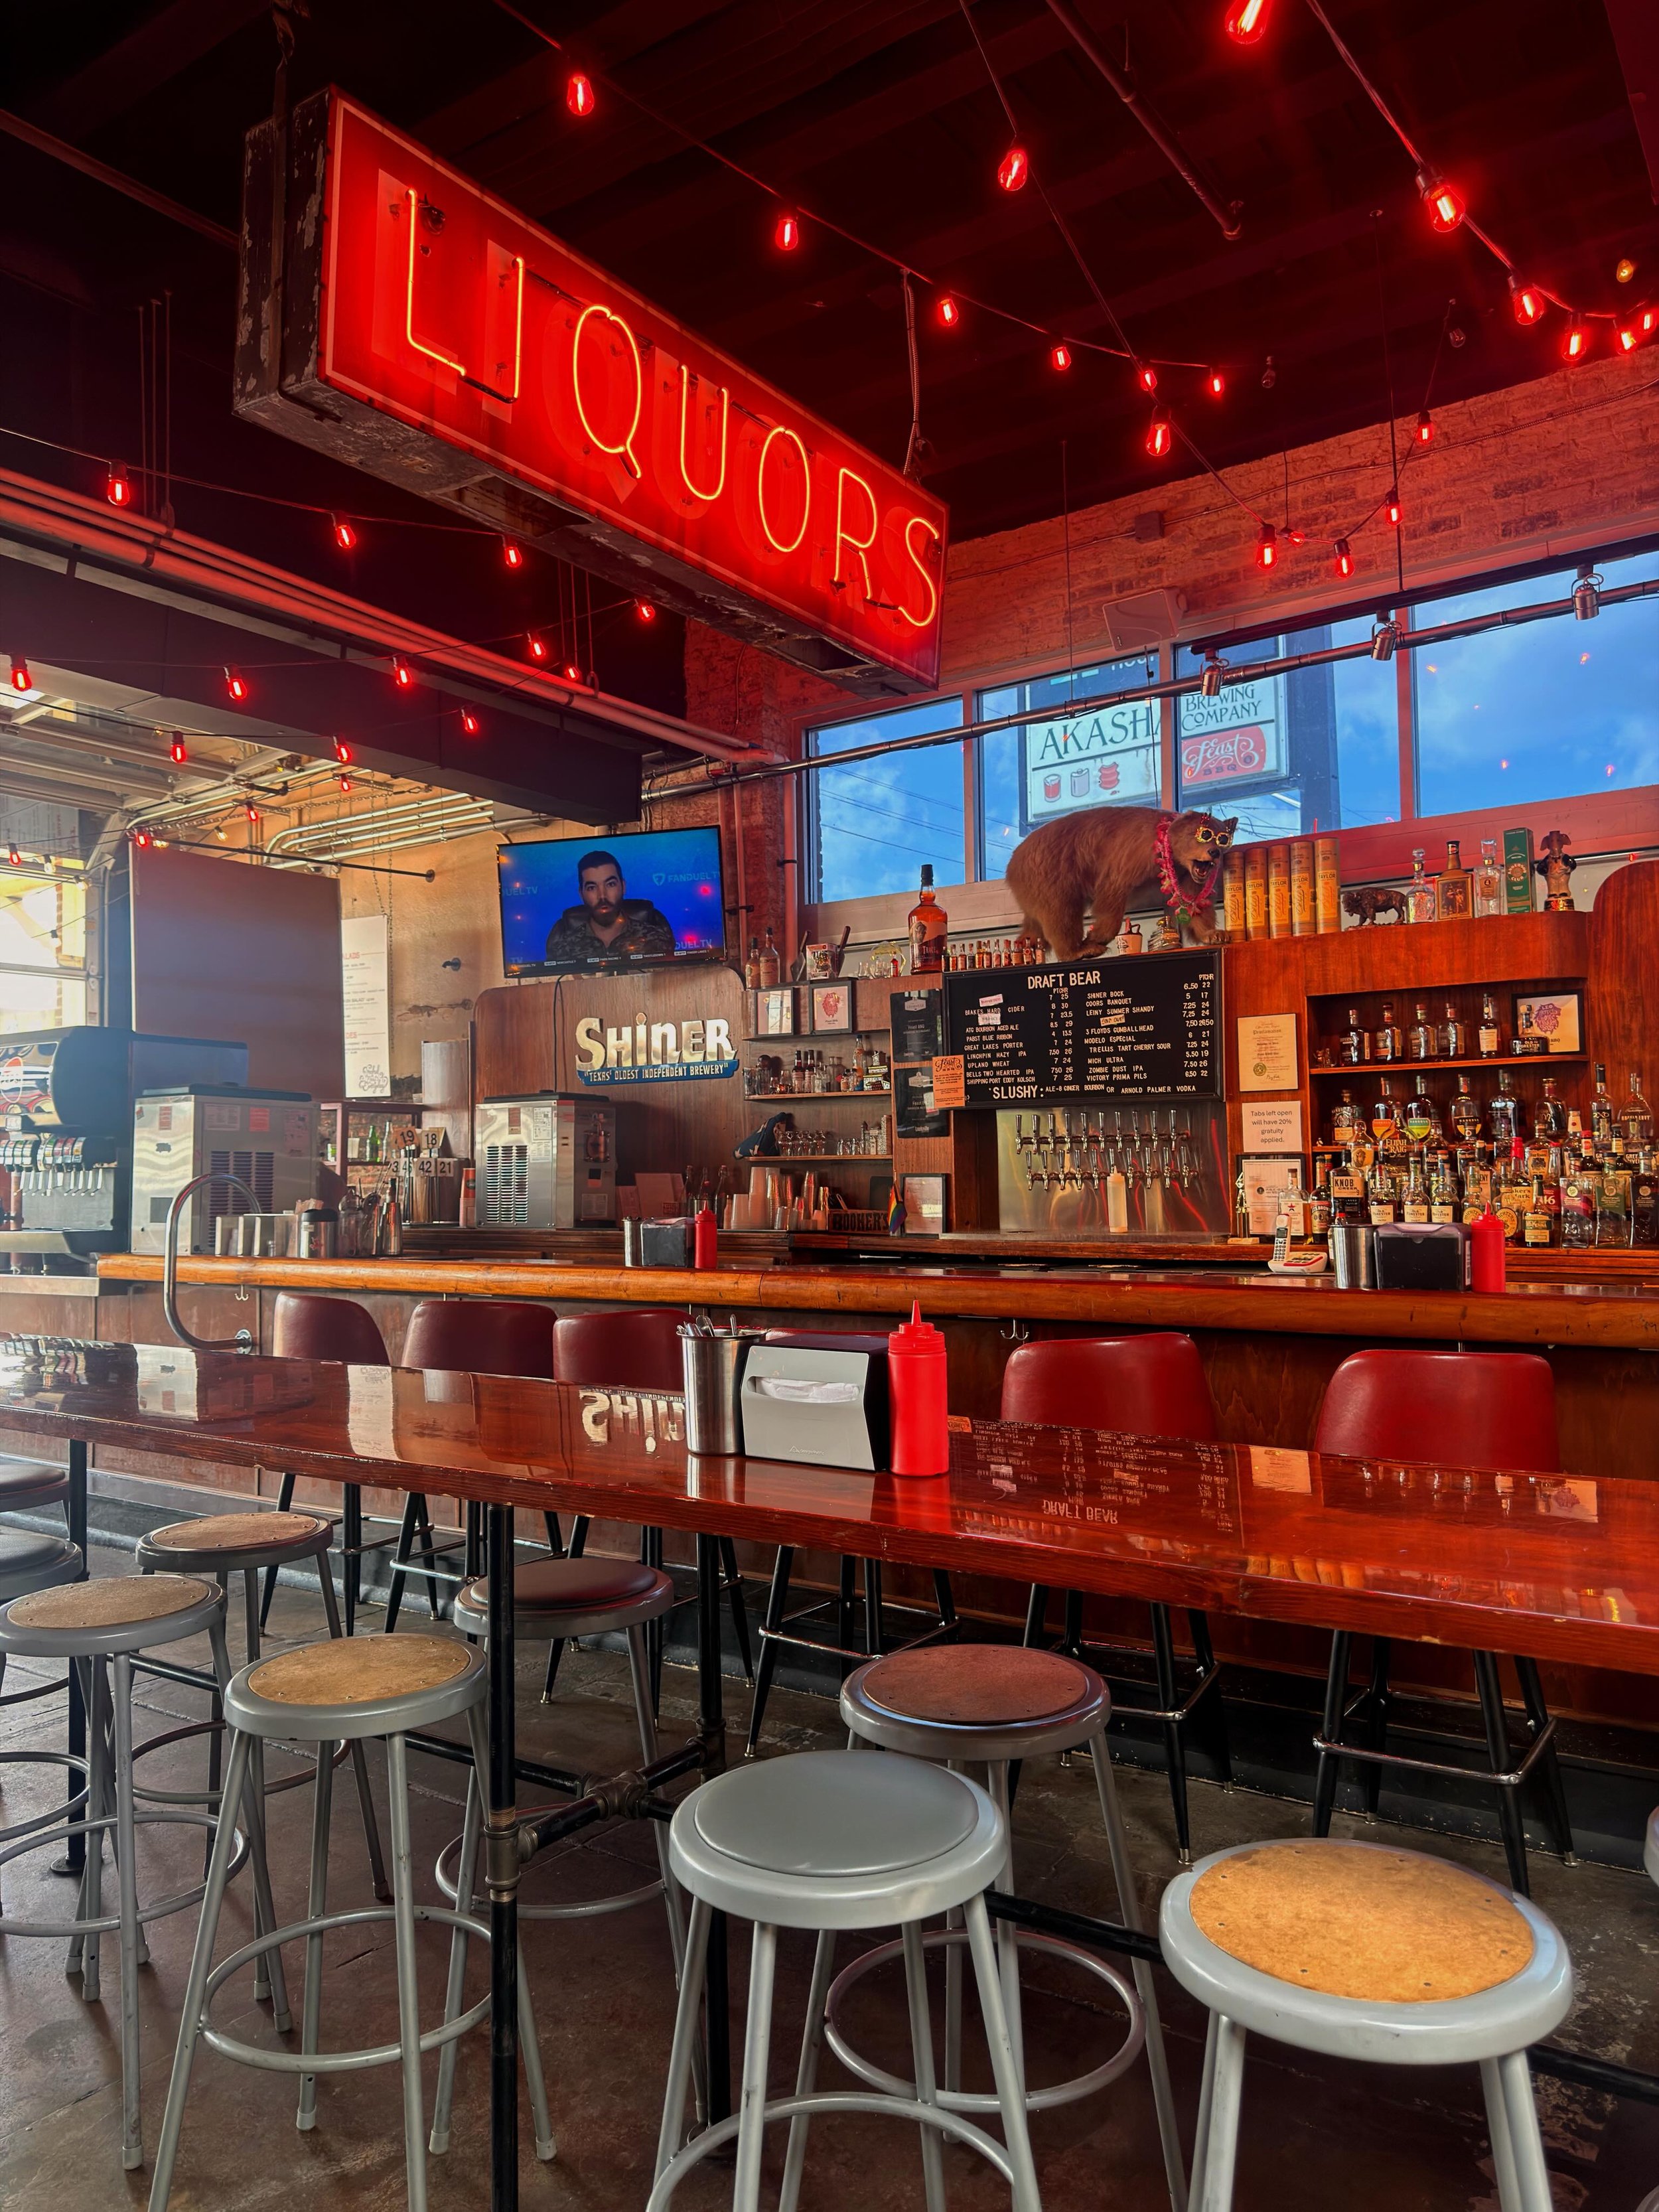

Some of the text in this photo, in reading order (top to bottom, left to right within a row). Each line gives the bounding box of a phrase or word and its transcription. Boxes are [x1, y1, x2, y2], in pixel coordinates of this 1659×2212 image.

[374, 169, 940, 636] LIQUORS
[1186, 684, 1255, 712] BREWING
[1182, 701, 1262, 731] COMPANY
[1203, 765, 1236, 776] BBQ
[668, 873, 711, 883] FANDUEL
[700, 939, 712, 948] TV
[1028, 970, 1101, 989] DRAFT BEAR
[614, 1069, 638, 1080] OLDEST
[642, 1066, 687, 1078] INDEPENDENT
[400, 1130, 415, 1143] 19
[425, 1134, 437, 1145] 18
[419, 1161, 431, 1173] 42
[440, 1161, 451, 1173] 21
